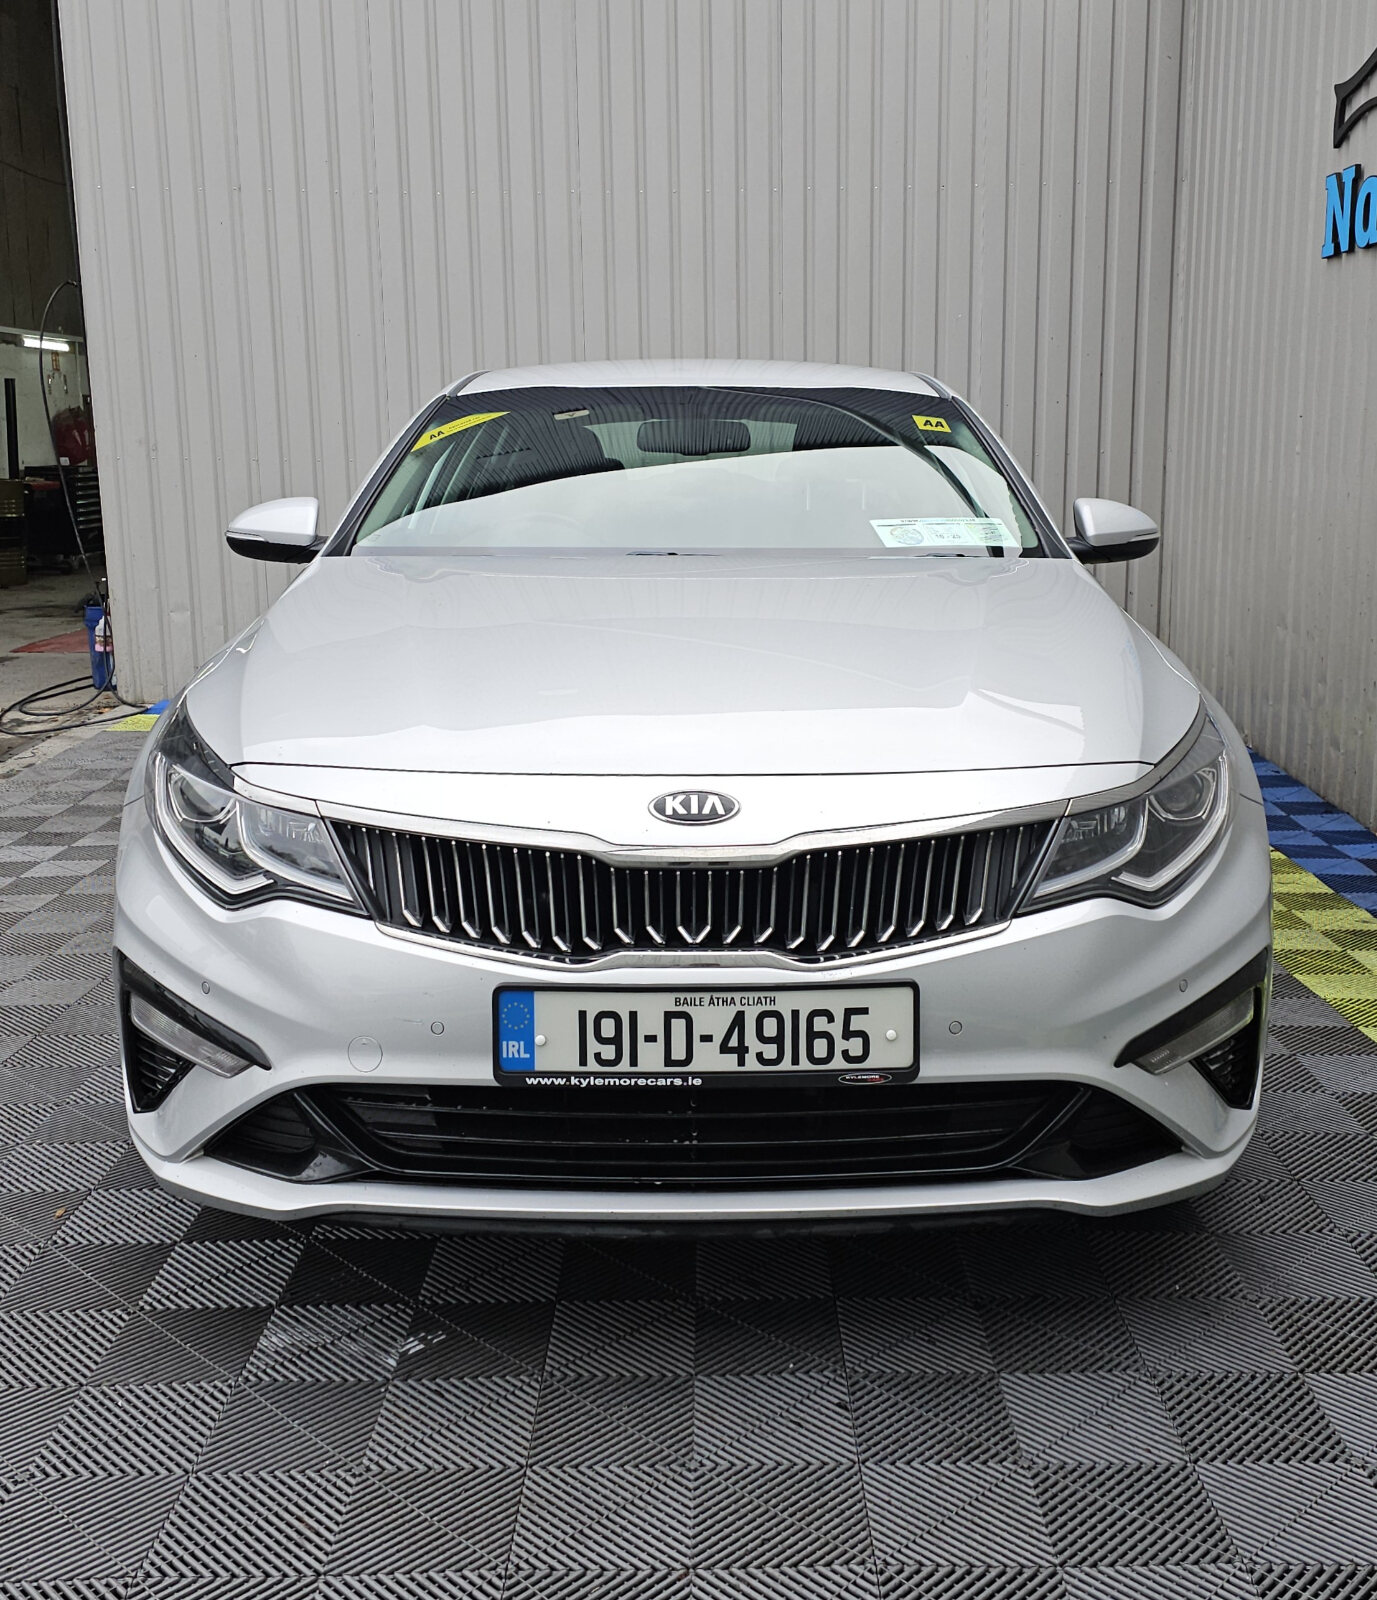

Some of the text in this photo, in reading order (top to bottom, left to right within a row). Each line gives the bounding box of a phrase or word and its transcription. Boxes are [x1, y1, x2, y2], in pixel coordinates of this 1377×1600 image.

[923, 419, 945, 428] AA
[429, 430, 445, 440] AA
[664, 794, 726, 815] KIA
[674, 994, 776, 1007] BAILE ÁTHA CLIATH
[577, 1007, 871, 1068] 191-D-49165
[502, 1040, 531, 1059] IRL
[525, 1075, 703, 1088] www.kylemorecars.ie
